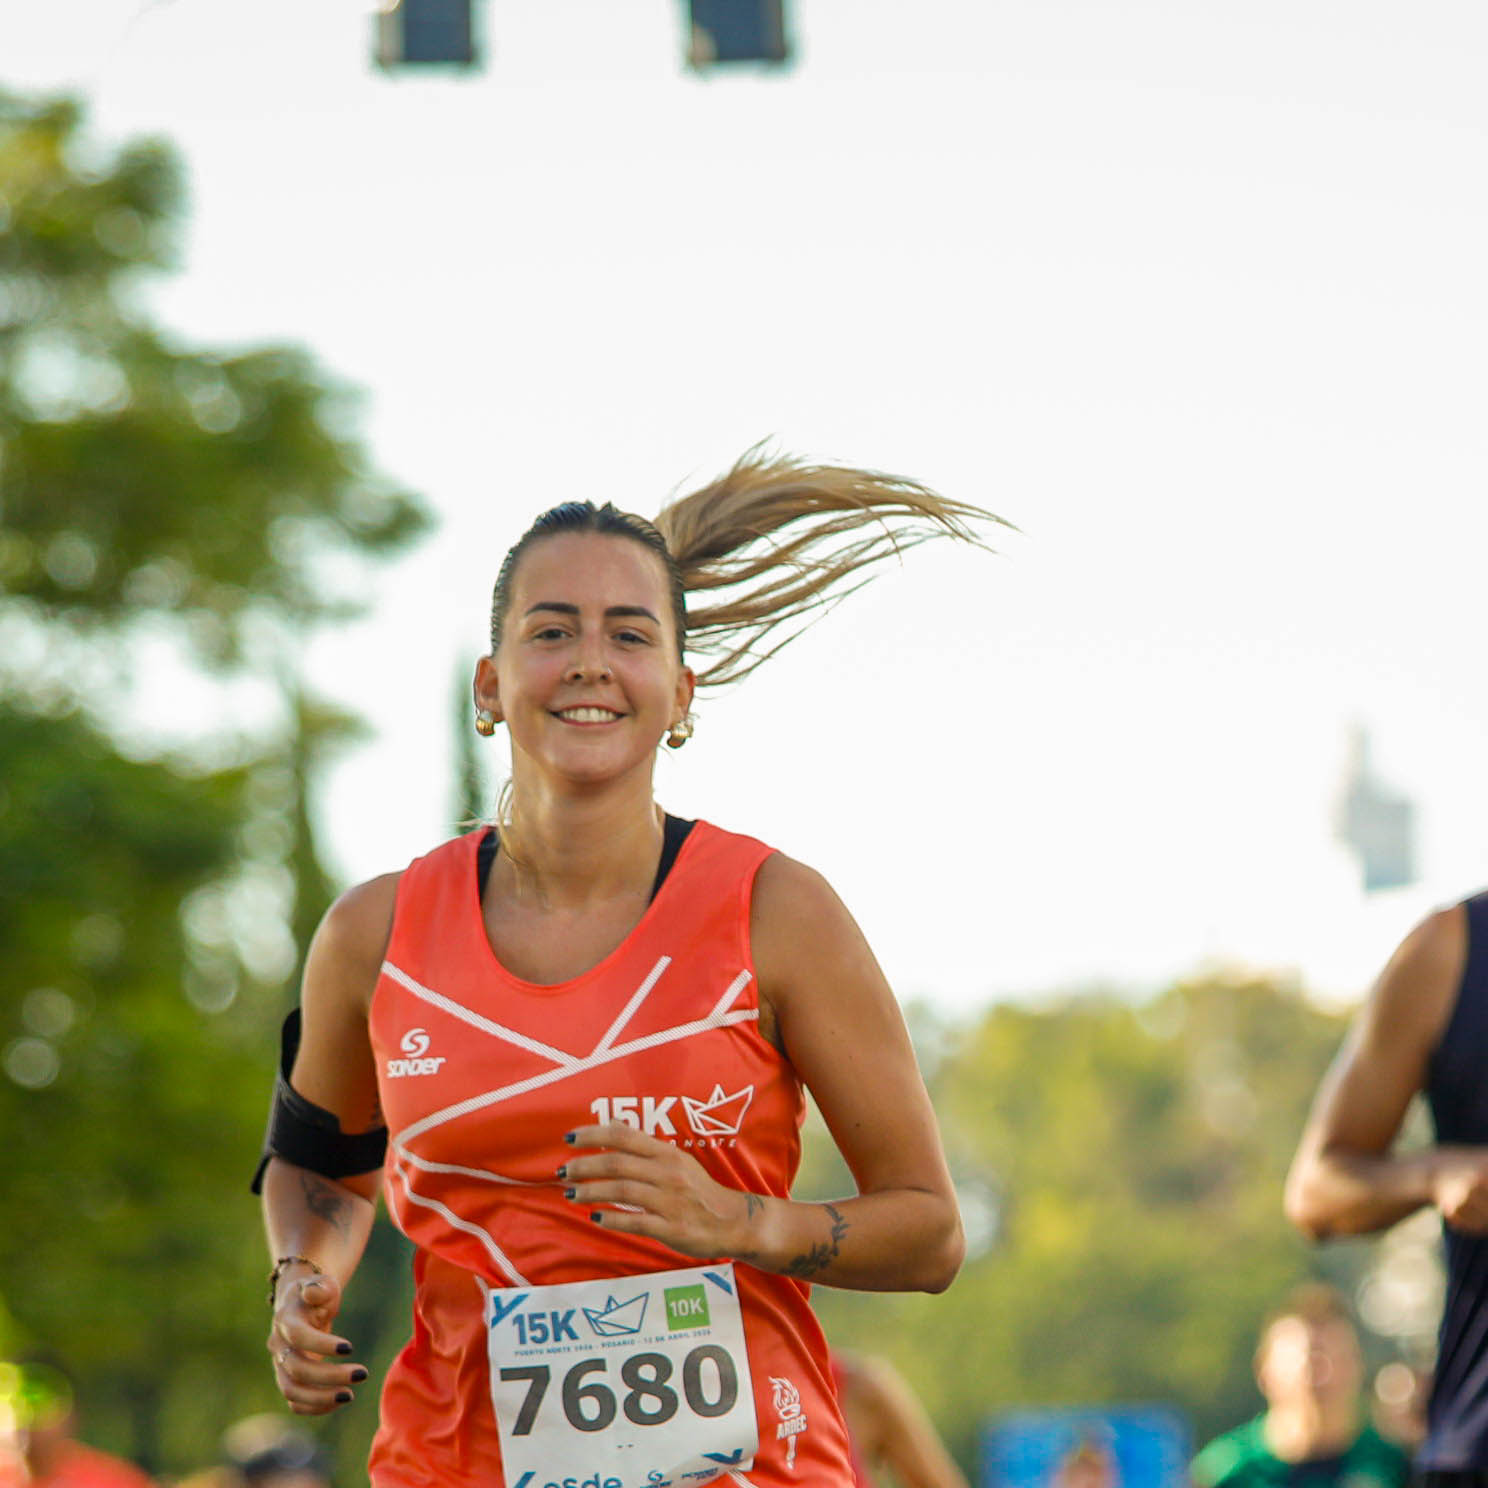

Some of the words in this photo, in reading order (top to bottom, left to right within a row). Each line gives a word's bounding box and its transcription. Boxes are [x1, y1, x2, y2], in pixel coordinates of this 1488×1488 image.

[590, 1096, 678, 1136] 15K
[669, 1297, 706, 1318] 10K
[513, 1309, 579, 1345] 15K
[499, 1343, 740, 1437] 7680
[776, 1413, 808, 1441] ARDEC
